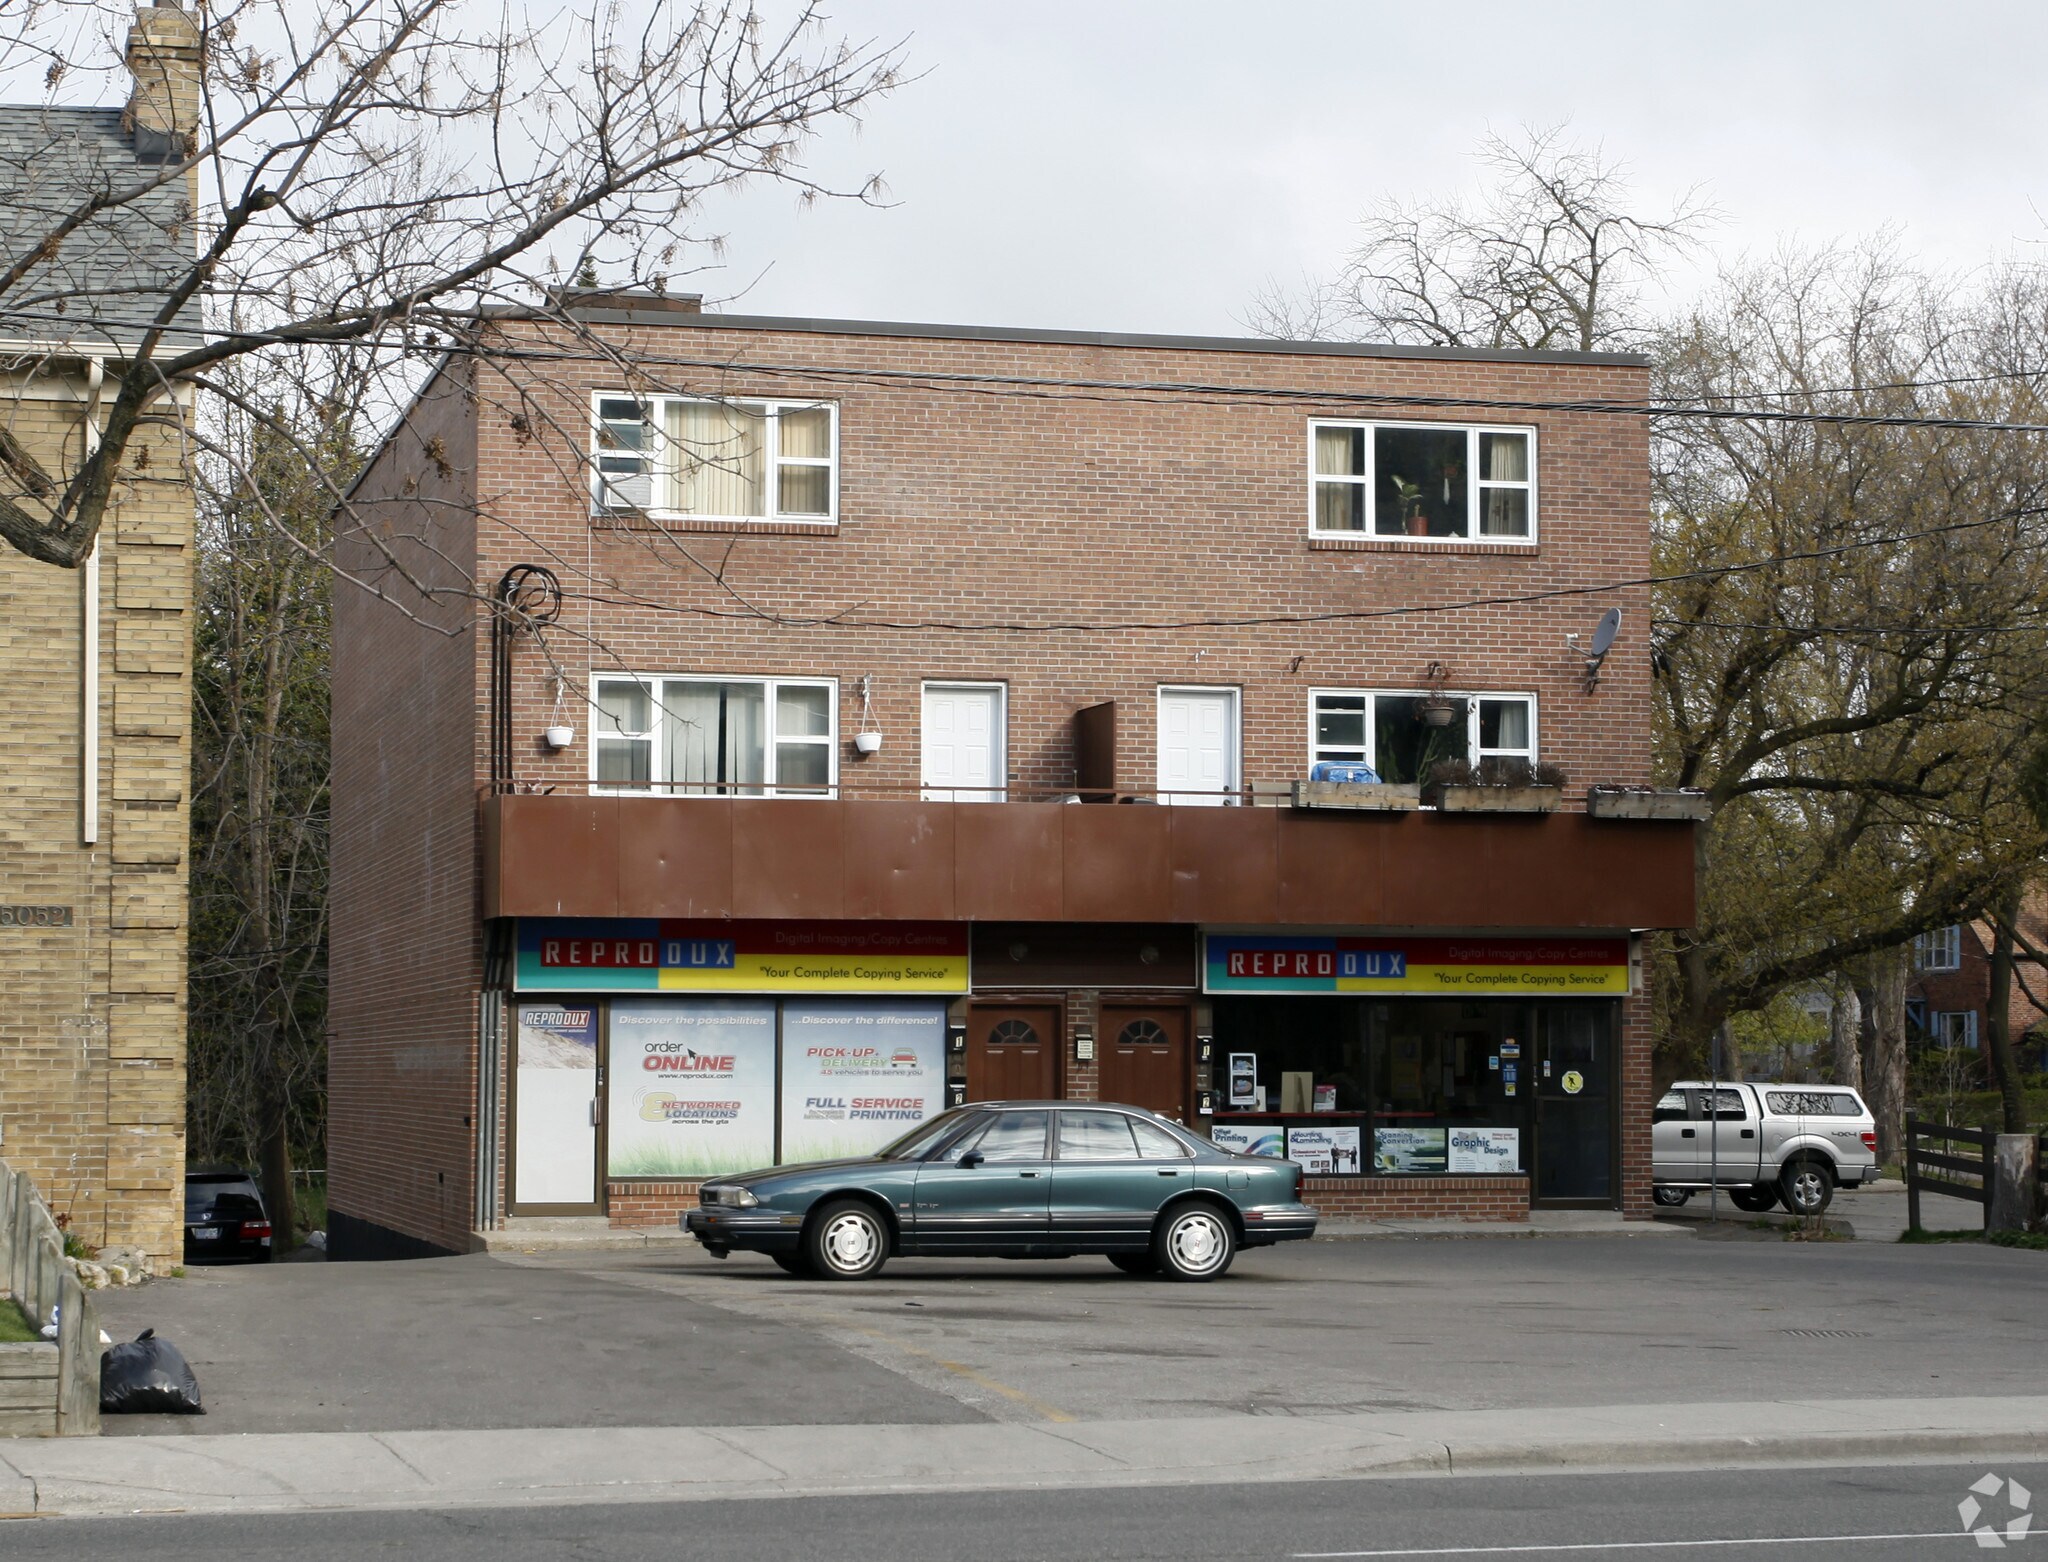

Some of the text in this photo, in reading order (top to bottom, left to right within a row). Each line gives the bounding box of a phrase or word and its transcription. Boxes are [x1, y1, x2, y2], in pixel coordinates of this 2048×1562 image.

[775, 931, 948, 947] Digital Imaging/Copy Centres
[545, 941, 729, 965] REPRODUX
[1449, 946, 1609, 961] Digital Imaging/Copy Centres
[1231, 952, 1401, 975] REPRODUX
[794, 966, 850, 980] Complete
[853, 967, 901, 980] Copying
[1465, 972, 1518, 985] Complete
[1521, 973, 1566, 986] Copying
[525, 1012, 587, 1025] REPRODUX
[618, 1016, 768, 1026] Discover the possibilities
[855, 1016, 874, 1025] the
[876, 1016, 938, 1025] difference!
[644, 1041, 683, 1053] order
[643, 1055, 735, 1072] ONLINE
[821, 1059, 888, 1067] DELIVERY
[661, 1101, 741, 1109] NETWORKED
[806, 1098, 924, 1108] FULL SERVICE
[665, 1110, 737, 1118] LOCATIONS
[850, 1110, 922, 1120] PRINTING
[1215, 1133, 1248, 1143] Printing
[1451, 1137, 1490, 1149] Graphic
[1484, 1146, 1508, 1156] Design
